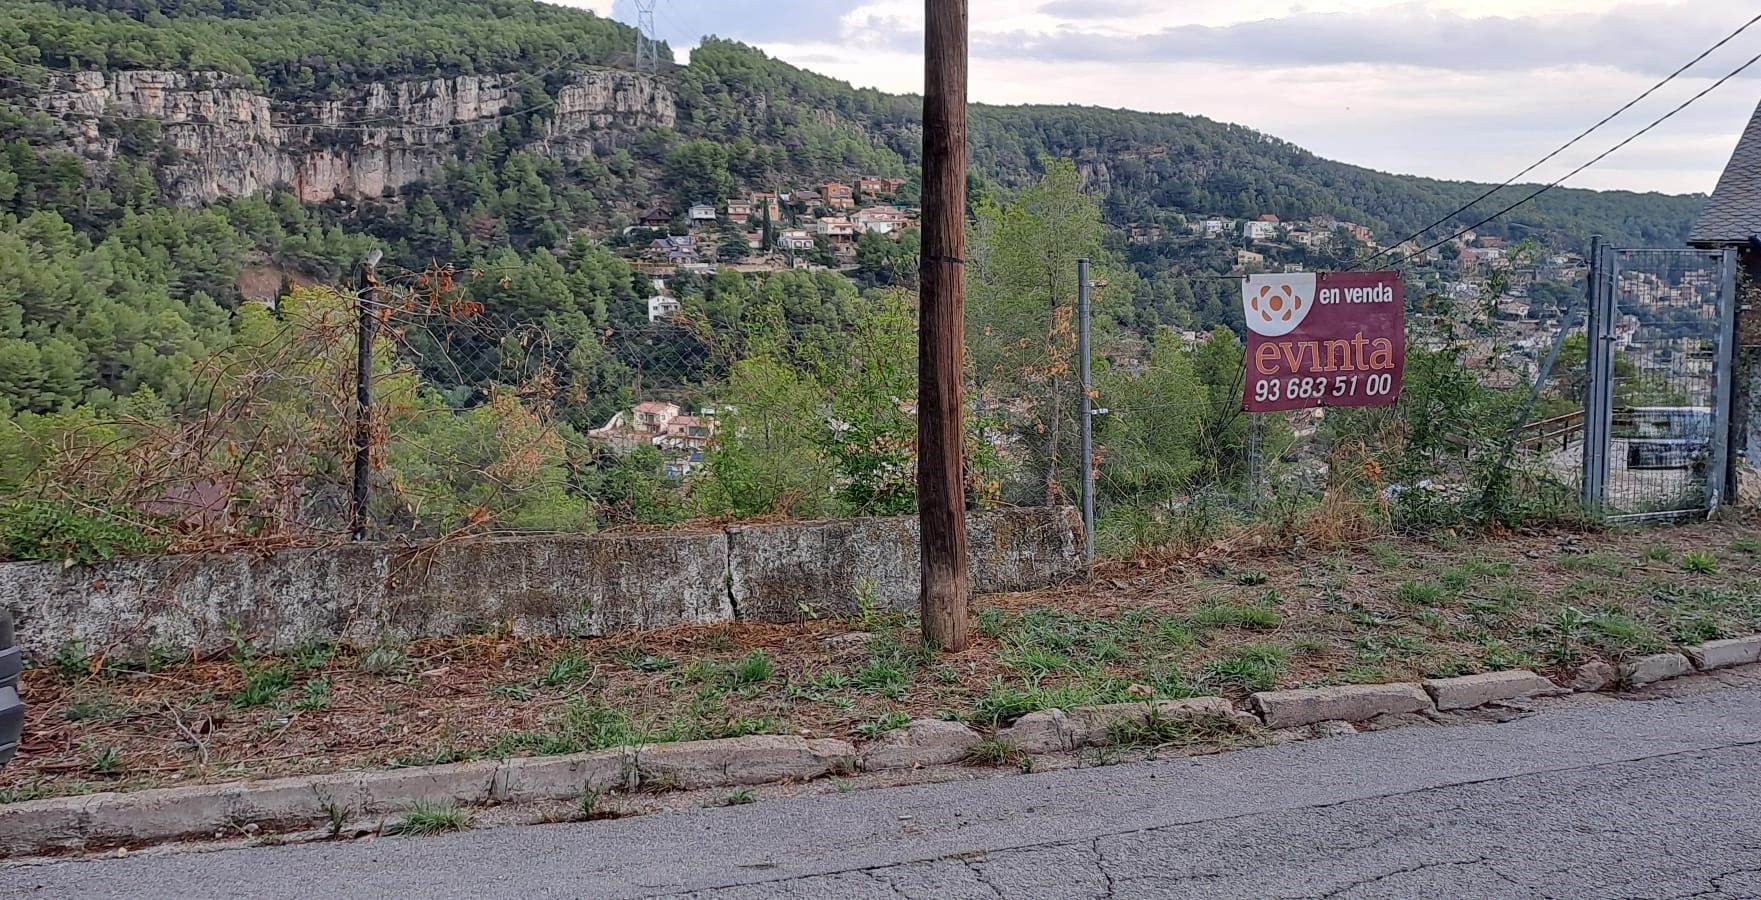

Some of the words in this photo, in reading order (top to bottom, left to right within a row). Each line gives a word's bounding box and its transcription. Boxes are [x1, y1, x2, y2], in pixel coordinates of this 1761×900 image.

[1319, 287, 1340, 304] en
[1344, 282, 1393, 304] venda
[1255, 331, 1395, 375] evinta
[1254, 379, 1281, 402] 93
[1286, 376, 1328, 400] 683
[1332, 375, 1358, 397] 51
[1366, 373, 1392, 396] 00
